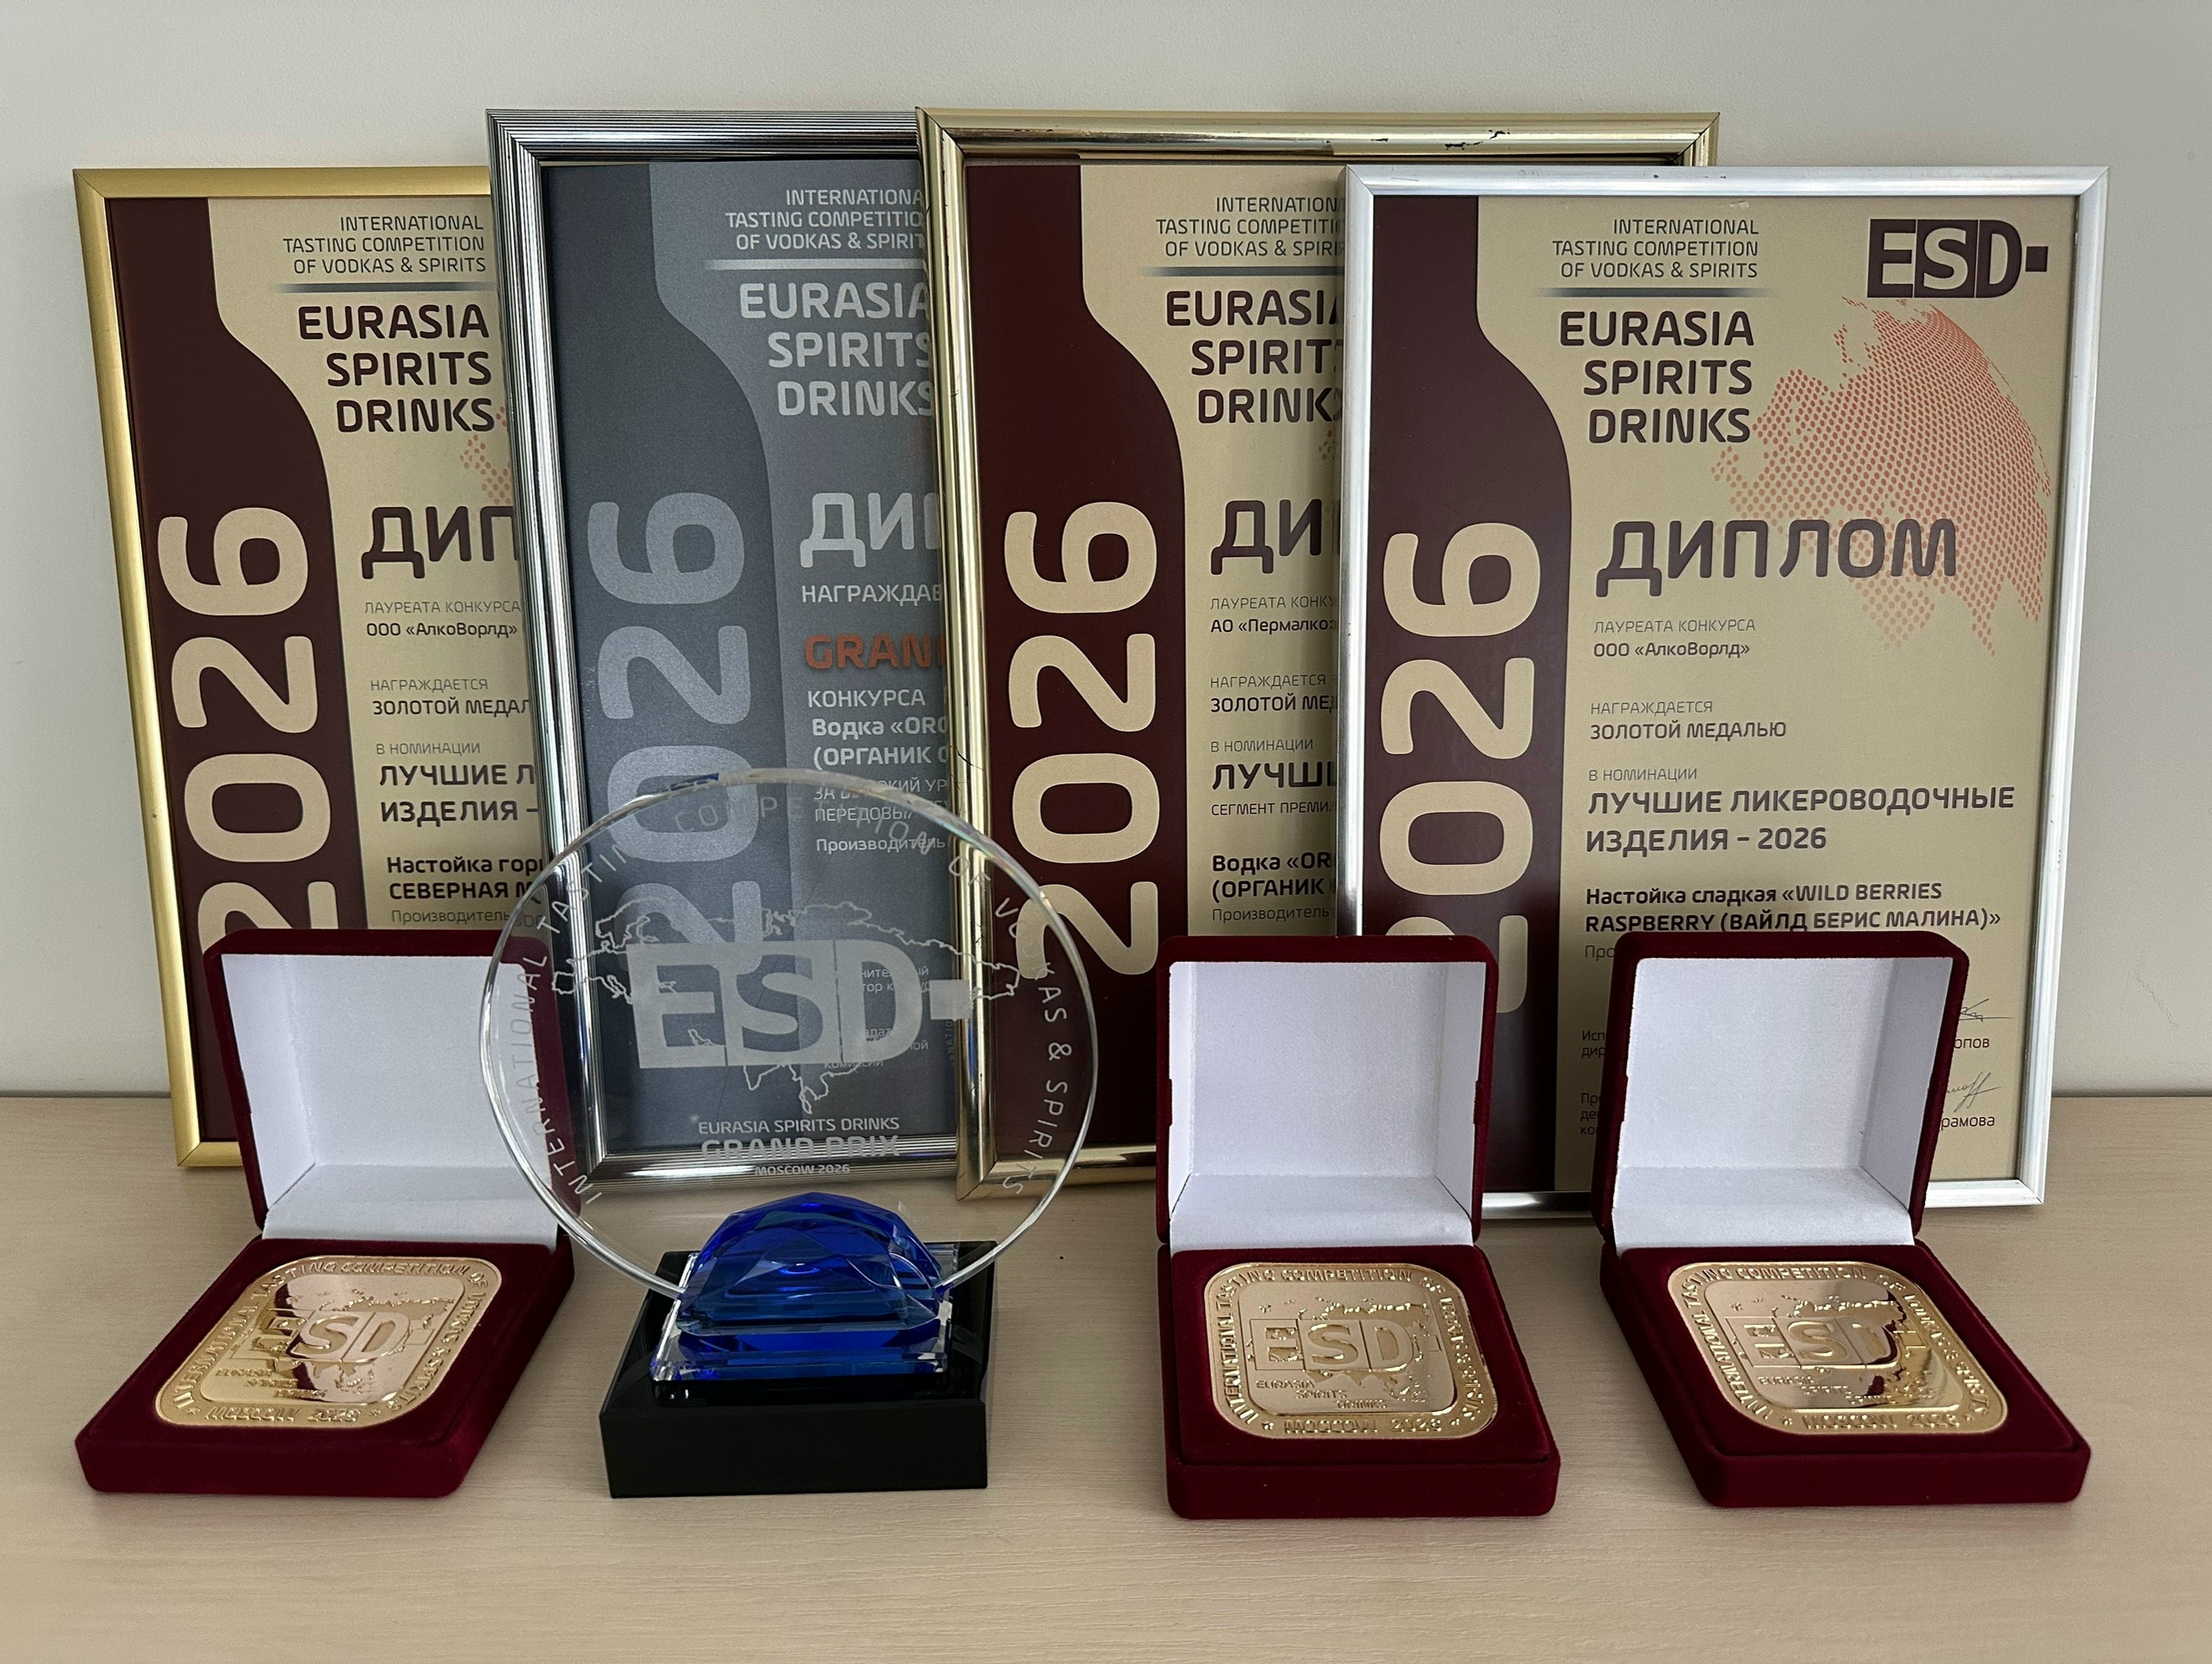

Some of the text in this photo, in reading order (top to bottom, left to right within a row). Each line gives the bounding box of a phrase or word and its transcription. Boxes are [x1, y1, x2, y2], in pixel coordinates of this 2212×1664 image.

[340, 215, 485, 232] INTERNATIONAL
[725, 211, 803, 229] TASTING
[1155, 218, 1338, 235] TASTING COMPETITI
[1612, 218, 1760, 237] INTERNATIONAL
[283, 235, 485, 254] TASTING COMPETITION
[736, 234, 760, 251] OF
[766, 233, 842, 250] VODKAS
[847, 232, 862, 250] &
[1164, 241, 1188, 257] OF
[1194, 240, 1269, 257] VODKAS
[1273, 239, 1287, 257] &
[1552, 239, 1760, 258] TASTING COMPETITION
[293, 257, 487, 275] OF VODKAS & SPIRITS
[1866, 218, 2023, 299] ESD
[1560, 260, 1759, 279] OF VODKAS & SPIRITS
[298, 302, 491, 341] EURASIA
[1558, 309, 1755, 348] EURASIA
[1191, 339, 1337, 376] SPIRIT
[326, 351, 492, 387] SPIRITS
[1583, 358, 1753, 396] SPIRITS
[335, 397, 496, 433] DRINKS
[1197, 387, 1338, 424] DRINK
[1588, 406, 1752, 445] DRINKS
[1594, 518, 1957, 599] ДИПЛОМ
[364, 600, 521, 615] ЛАУРЕАТА КОНКУРСА
[1210, 596, 1287, 610] ЛАУРЕАТА
[366, 621, 518, 639] ООО «АлкоВорлд»
[1210, 618, 1234, 634] АО
[1593, 618, 1756, 634] ЛАУРЕАТА КОНКУРСА
[1593, 640, 1751, 660] ООО «АлкоВорлд»
[370, 679, 488, 693] НАГРАЖДАЕТСЯ
[1210, 673, 1326, 690] НАГРАЖДАЕТСЯ
[373, 695, 460, 716] ЗОЛОТОЙ
[807, 689, 926, 708] КОНКУРСА
[1210, 692, 1333, 713] ЗОЛОТОЙ МЕ
[1590, 700, 1714, 717] НАГРАЖДАЕТСЯ
[811, 718, 885, 741] Водка
[1004, 500, 1161, 978] 2026
[1589, 719, 1787, 742] ЗОЛОТОЙ МЕДАЛЬЮ
[375, 743, 481, 757] В НОМИНАЦИИ
[1211, 738, 1314, 754] В НОМИНАЦИИ
[813, 746, 932, 770] (ОРГАНИК
[380, 764, 508, 787] ЛУЧШИЕ
[1588, 767, 1698, 783] В НОМИНАЦИИ
[1211, 801, 1332, 816] СЕГМЕНТ ПРЕМИ
[1587, 785, 2016, 817] ЛУЧШИЕ ЛИКЕРОВОДОЧНЫЕ
[381, 799, 518, 828] ИЗДЕЛИЯ
[1585, 826, 1828, 858] ИЗДЕЛИЯ 2026
[387, 856, 495, 874] Настойка
[1212, 855, 1281, 876] Водка
[389, 881, 510, 901] СЕВЕРНАЯ
[1212, 877, 1325, 904] (ОРГАНИК
[1585, 881, 1942, 908] Настойка сладкая «WILD BERRIES
[1584, 907, 2001, 935] RASPBERRY (ВАЙЛД БЕРИС МАЛИНА)»
[626, 939, 923, 1069] ESD
[1047, 1042, 1073, 1063] &
[510, 955, 603, 1206] INTERNATIONAL
[699, 1117, 901, 1135] EURASIA SPIRITS DRINKS
[700, 1134, 901, 1161] GRAND PRIX
[1002, 1079, 1070, 1195] SPIRITS
[754, 1163, 851, 1176] MOSCOW 2026
